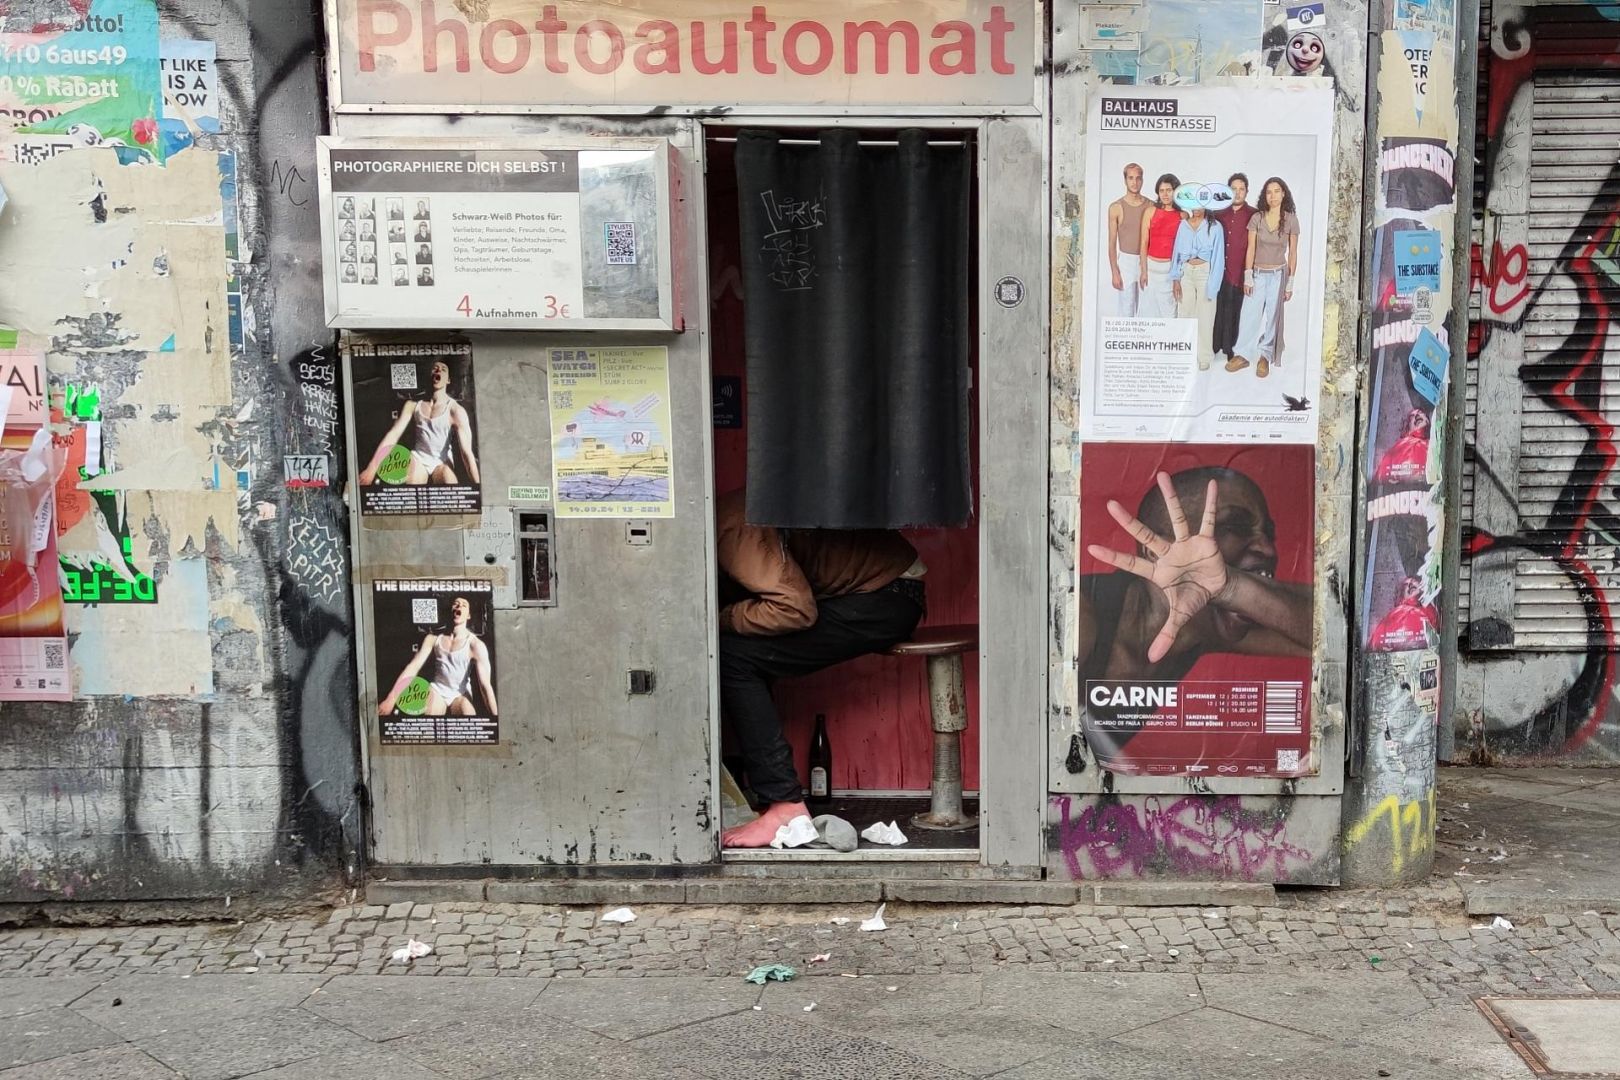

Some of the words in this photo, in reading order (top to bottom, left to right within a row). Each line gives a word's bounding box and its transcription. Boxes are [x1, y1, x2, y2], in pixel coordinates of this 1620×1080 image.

[358, 0, 1015, 75] Photoautomat
[46, 44, 127, 65] 6aus49
[173, 59, 206, 72] LIKE
[45, 75, 120, 98] Rabatt
[169, 74, 187, 90] IS
[193, 77, 208, 90] A
[1105, 101, 1175, 114] BALLHAUS
[1104, 117, 1212, 130] NAUNYNSTRASSE
[334, 161, 463, 173] PHOTOGRAPHIERE
[467, 161, 500, 173] DICH
[503, 161, 557, 173] SELBST
[452, 212, 513, 221] Schwarz-Weiß
[515, 212, 545, 221] Photos
[547, 212, 563, 221] für:
[1398, 264, 1410, 276] THE
[1411, 263, 1439, 276] SUBSTANCE
[456, 295, 473, 318] 4
[475, 308, 538, 318] Aufnahmen
[351, 345, 375, 357] THE
[377, 343, 471, 357] IRREPRESSIBLES
[1105, 340, 1192, 351] GEGENRHYTHMEN
[551, 350, 596, 361] SEA-
[551, 363, 597, 371] WATCH
[1410, 356, 1421, 372] THE
[388, 451, 401, 462] YO
[380, 459, 411, 475] HOMO!
[374, 580, 397, 592] THE
[399, 580, 491, 592] IRREPRESSIBLES
[408, 683, 420, 694] YO
[398, 691, 430, 706] HOMO!
[1090, 686, 1178, 707] CARNE
